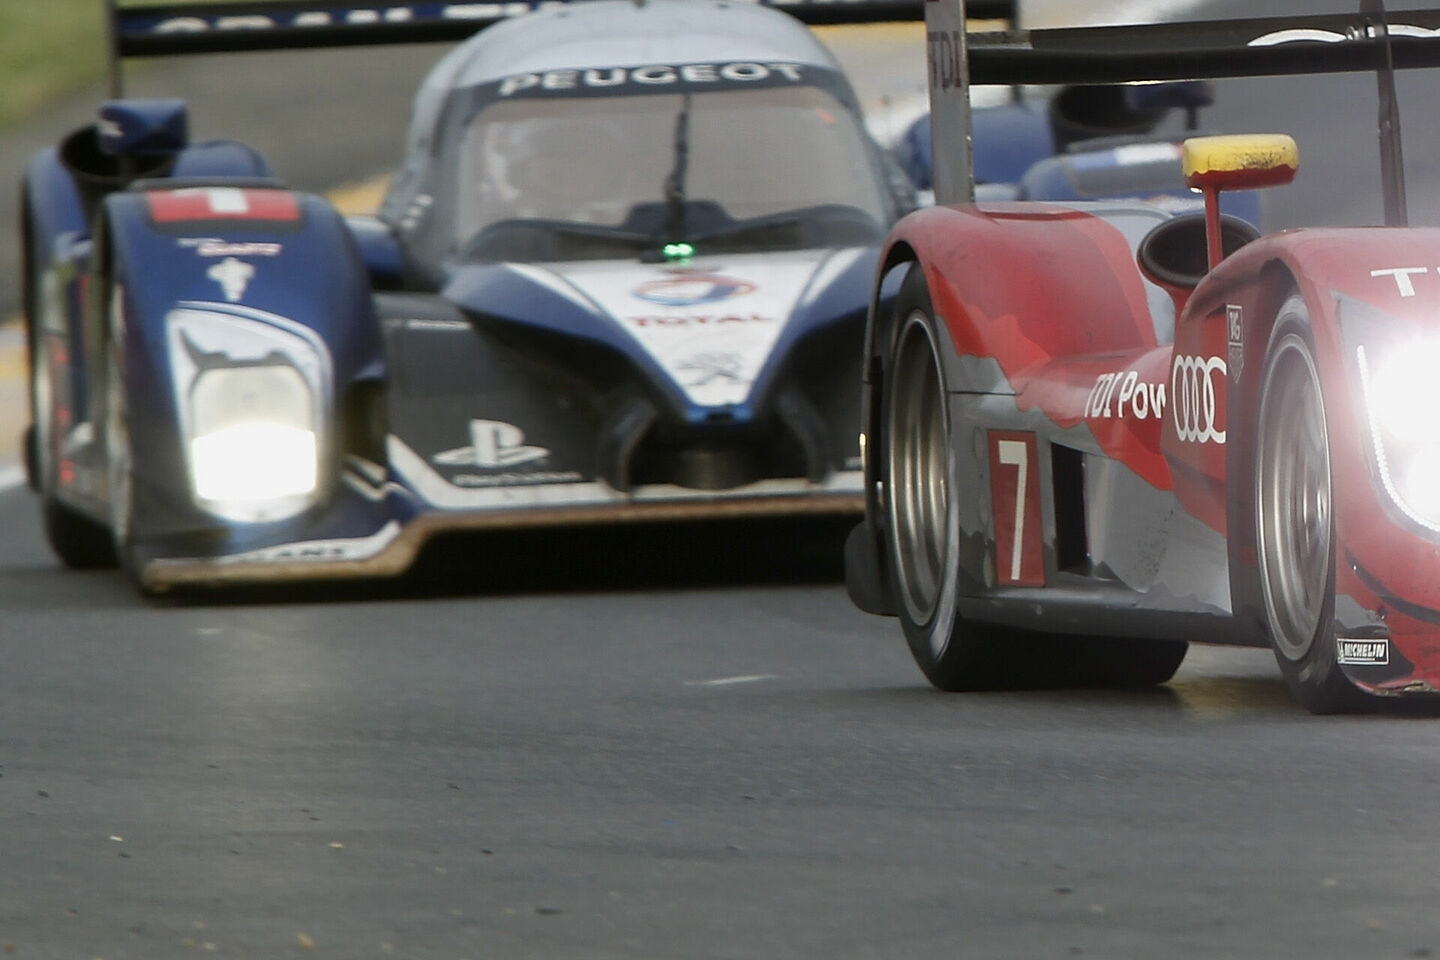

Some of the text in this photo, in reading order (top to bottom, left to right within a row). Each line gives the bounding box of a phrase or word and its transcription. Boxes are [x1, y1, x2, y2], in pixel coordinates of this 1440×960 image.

[500, 63, 801, 96] PEUGEOT
[1084, 372, 1125, 418] TDI
[998, 439, 1028, 581] 7
[1344, 643, 1386, 658] MICHELIN
